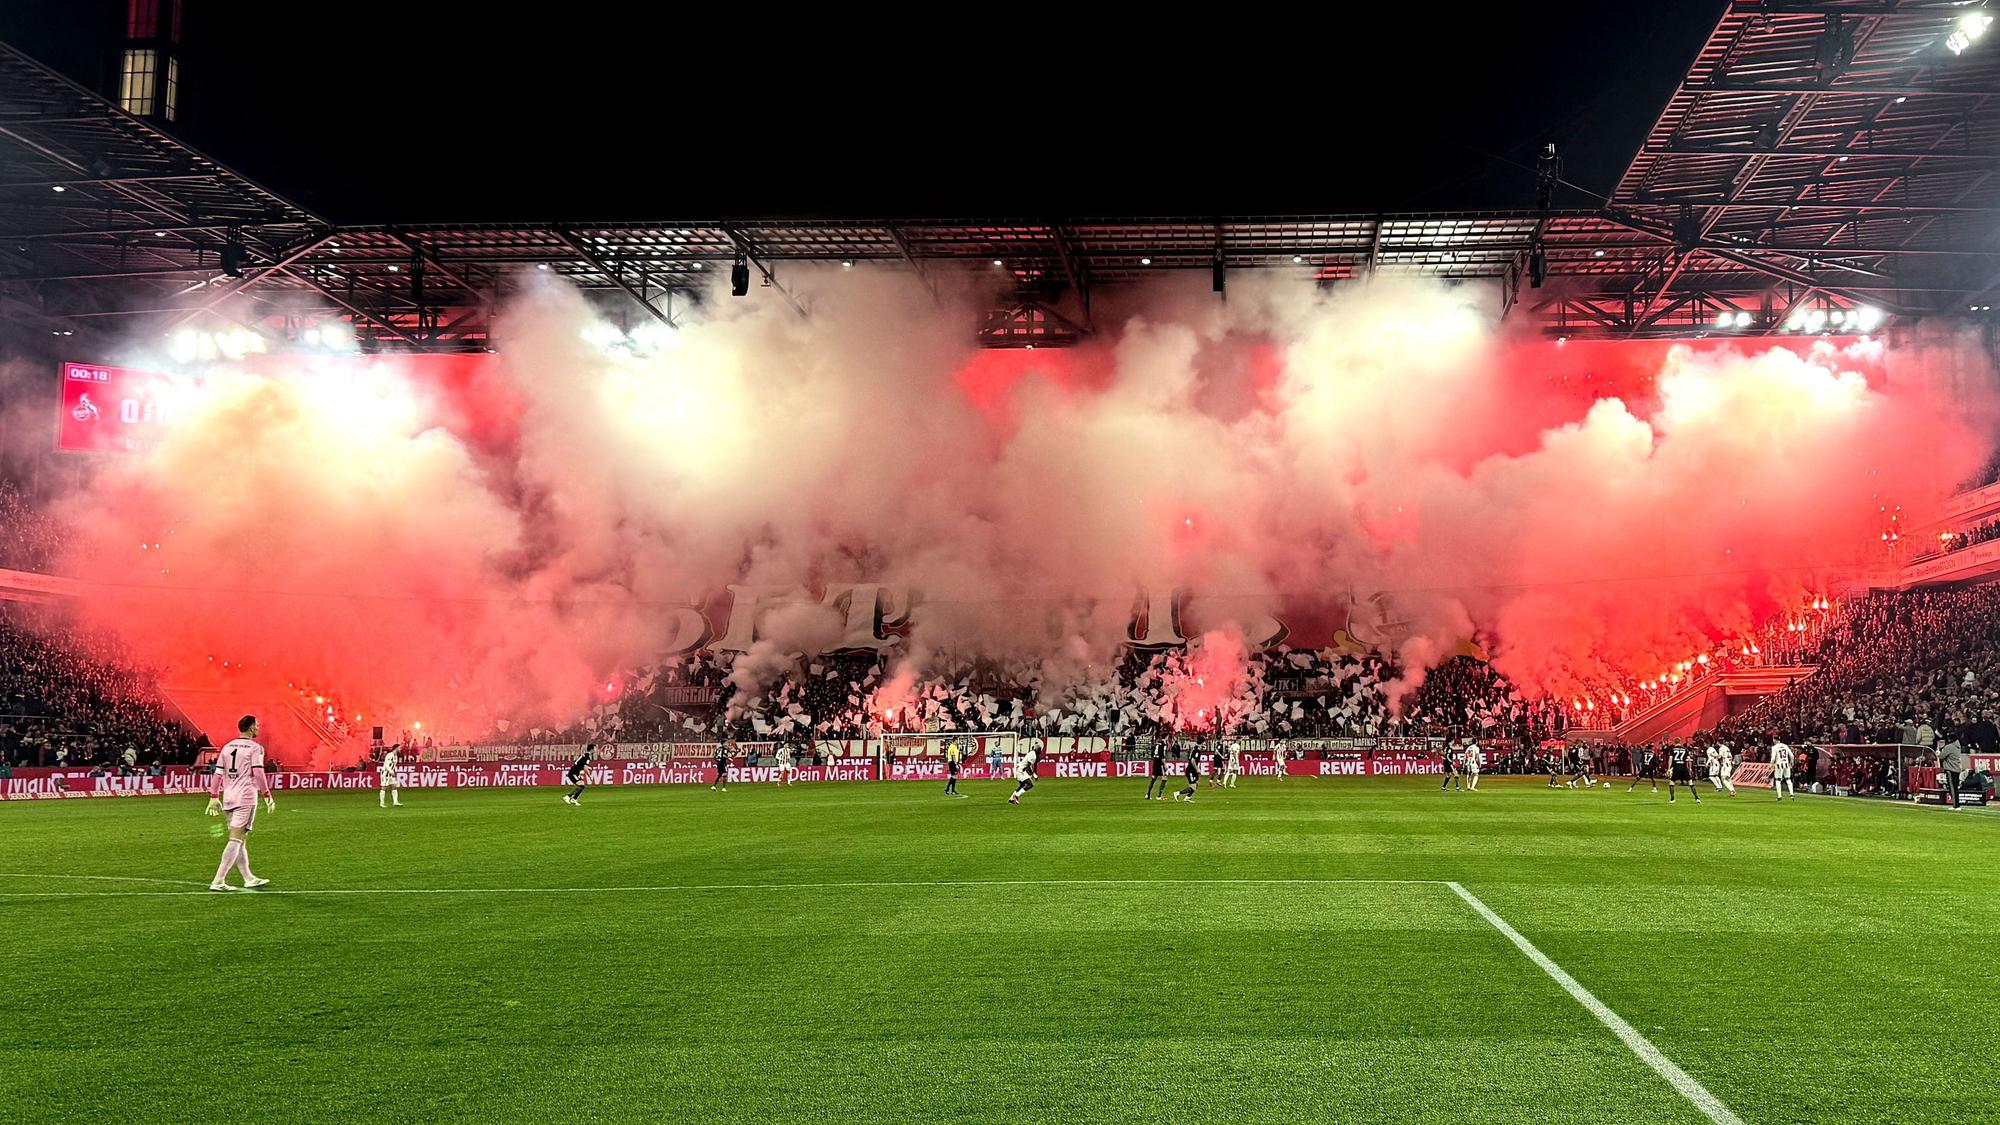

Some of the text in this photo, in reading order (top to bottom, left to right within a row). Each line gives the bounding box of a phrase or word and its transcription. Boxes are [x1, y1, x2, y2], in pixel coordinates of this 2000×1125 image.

[71, 368, 108, 381] 00:18
[229, 748, 238, 773] 1
[1673, 750, 1686, 761] 27
[1778, 749, 1787, 759] 13
[727, 765, 868, 782] REWE Dein Markt
[1056, 762, 1108, 777] REWE
[1320, 760, 1445, 775] REWE Dein Markt
[289, 772, 322, 789] Dein
[327, 772, 373, 788] Markt
[396, 770, 538, 787] REWE Dein Markt
[623, 769, 654, 784] Dein
[659, 768, 704, 784] Markt
